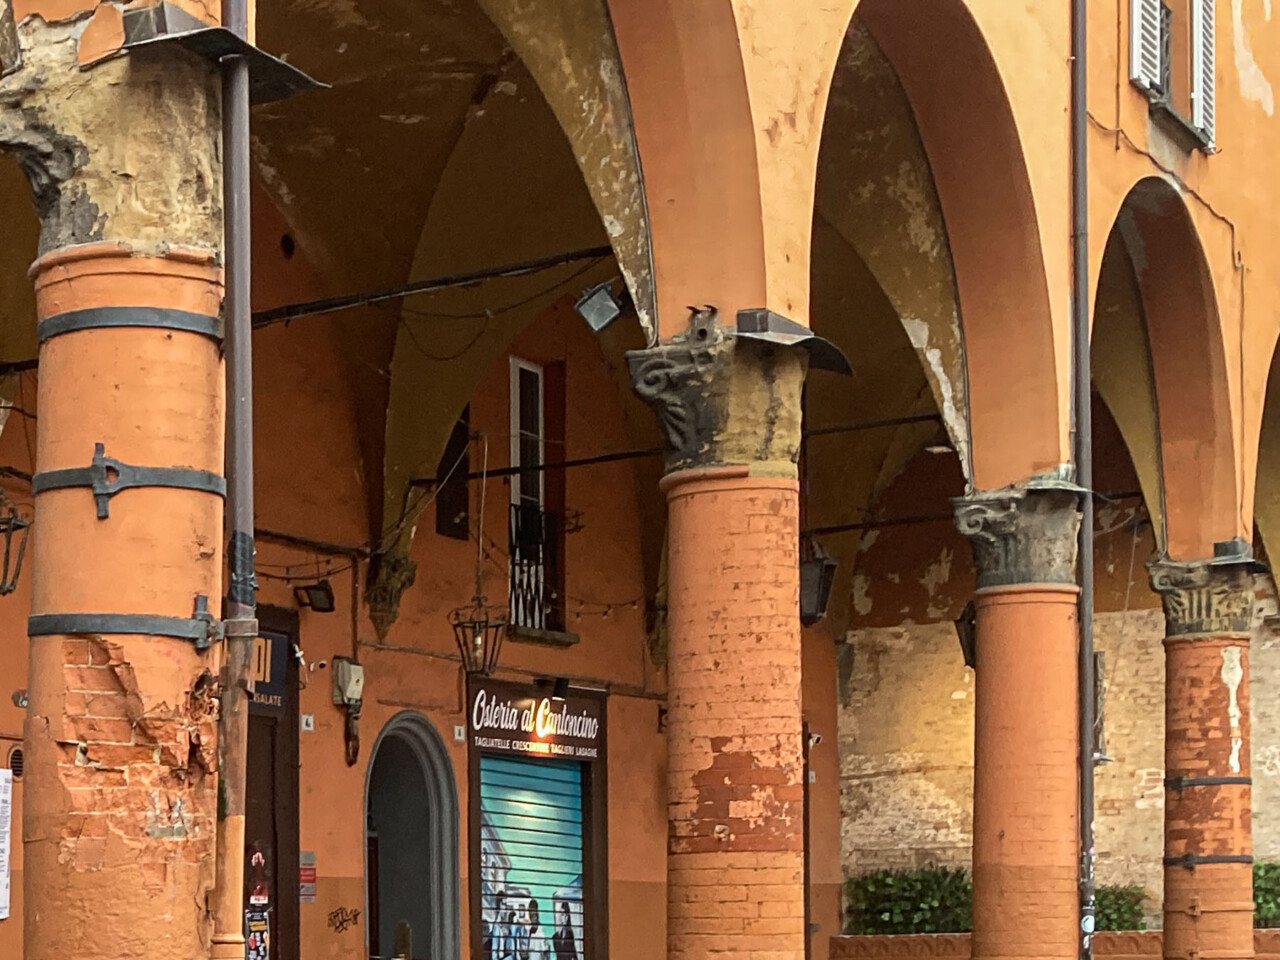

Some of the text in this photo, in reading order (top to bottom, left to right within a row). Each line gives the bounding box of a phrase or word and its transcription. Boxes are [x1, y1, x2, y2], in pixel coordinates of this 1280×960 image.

[473, 689, 599, 740] Osteria al Cantoncino
[474, 736, 510, 750] TAGLIATELLE
